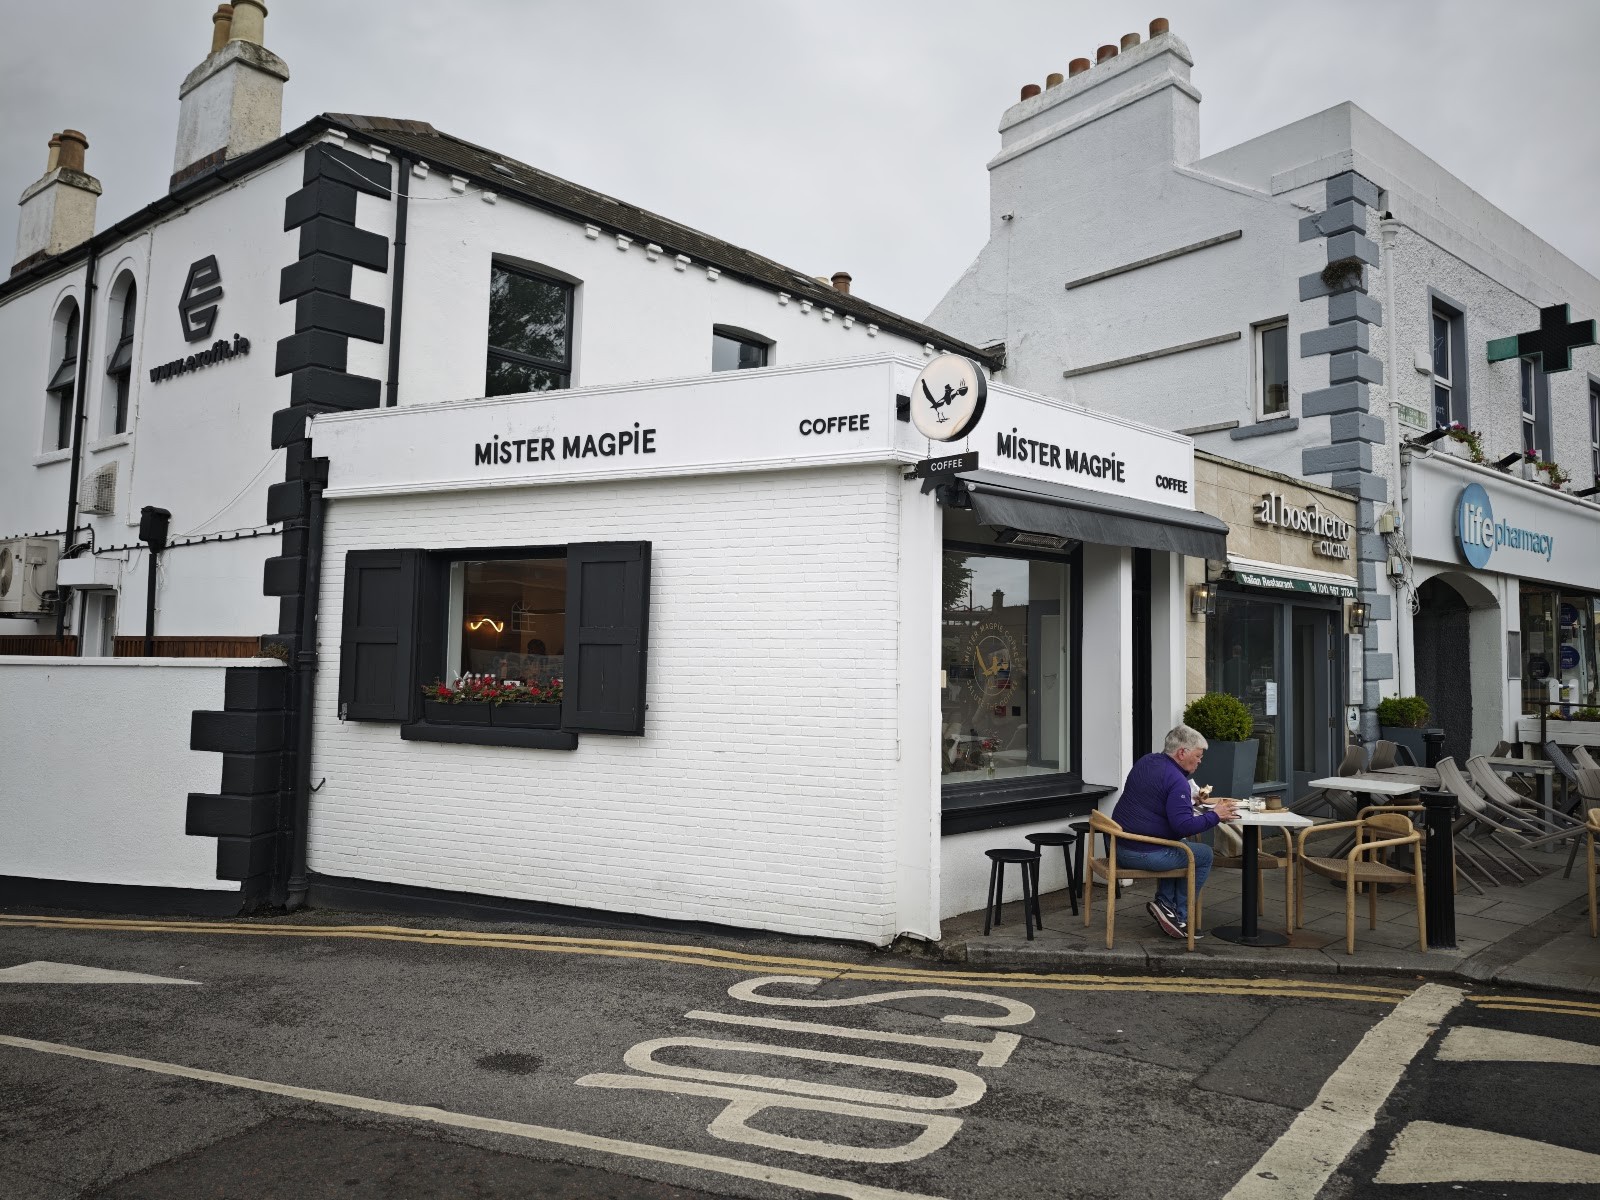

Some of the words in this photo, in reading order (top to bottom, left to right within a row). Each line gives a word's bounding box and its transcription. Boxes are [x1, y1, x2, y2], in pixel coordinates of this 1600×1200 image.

[150, 333, 250, 384] www.exofit.ie
[799, 413, 870, 436] COFFEE
[930, 458, 963, 472] COFFEE
[1155, 474, 1188, 494] COFFEE
[1261, 491, 1277, 524] al
[1279, 494, 1351, 540] boschetto
[1463, 502, 1494, 548] life
[1494, 518, 1553, 562] pharmacy
[1320, 540, 1351, 560] CUCINA
[1241, 573, 1261, 586] Italian
[1262, 576, 1295, 589] Restaurant
[574, 975, 1037, 1164] STOP
